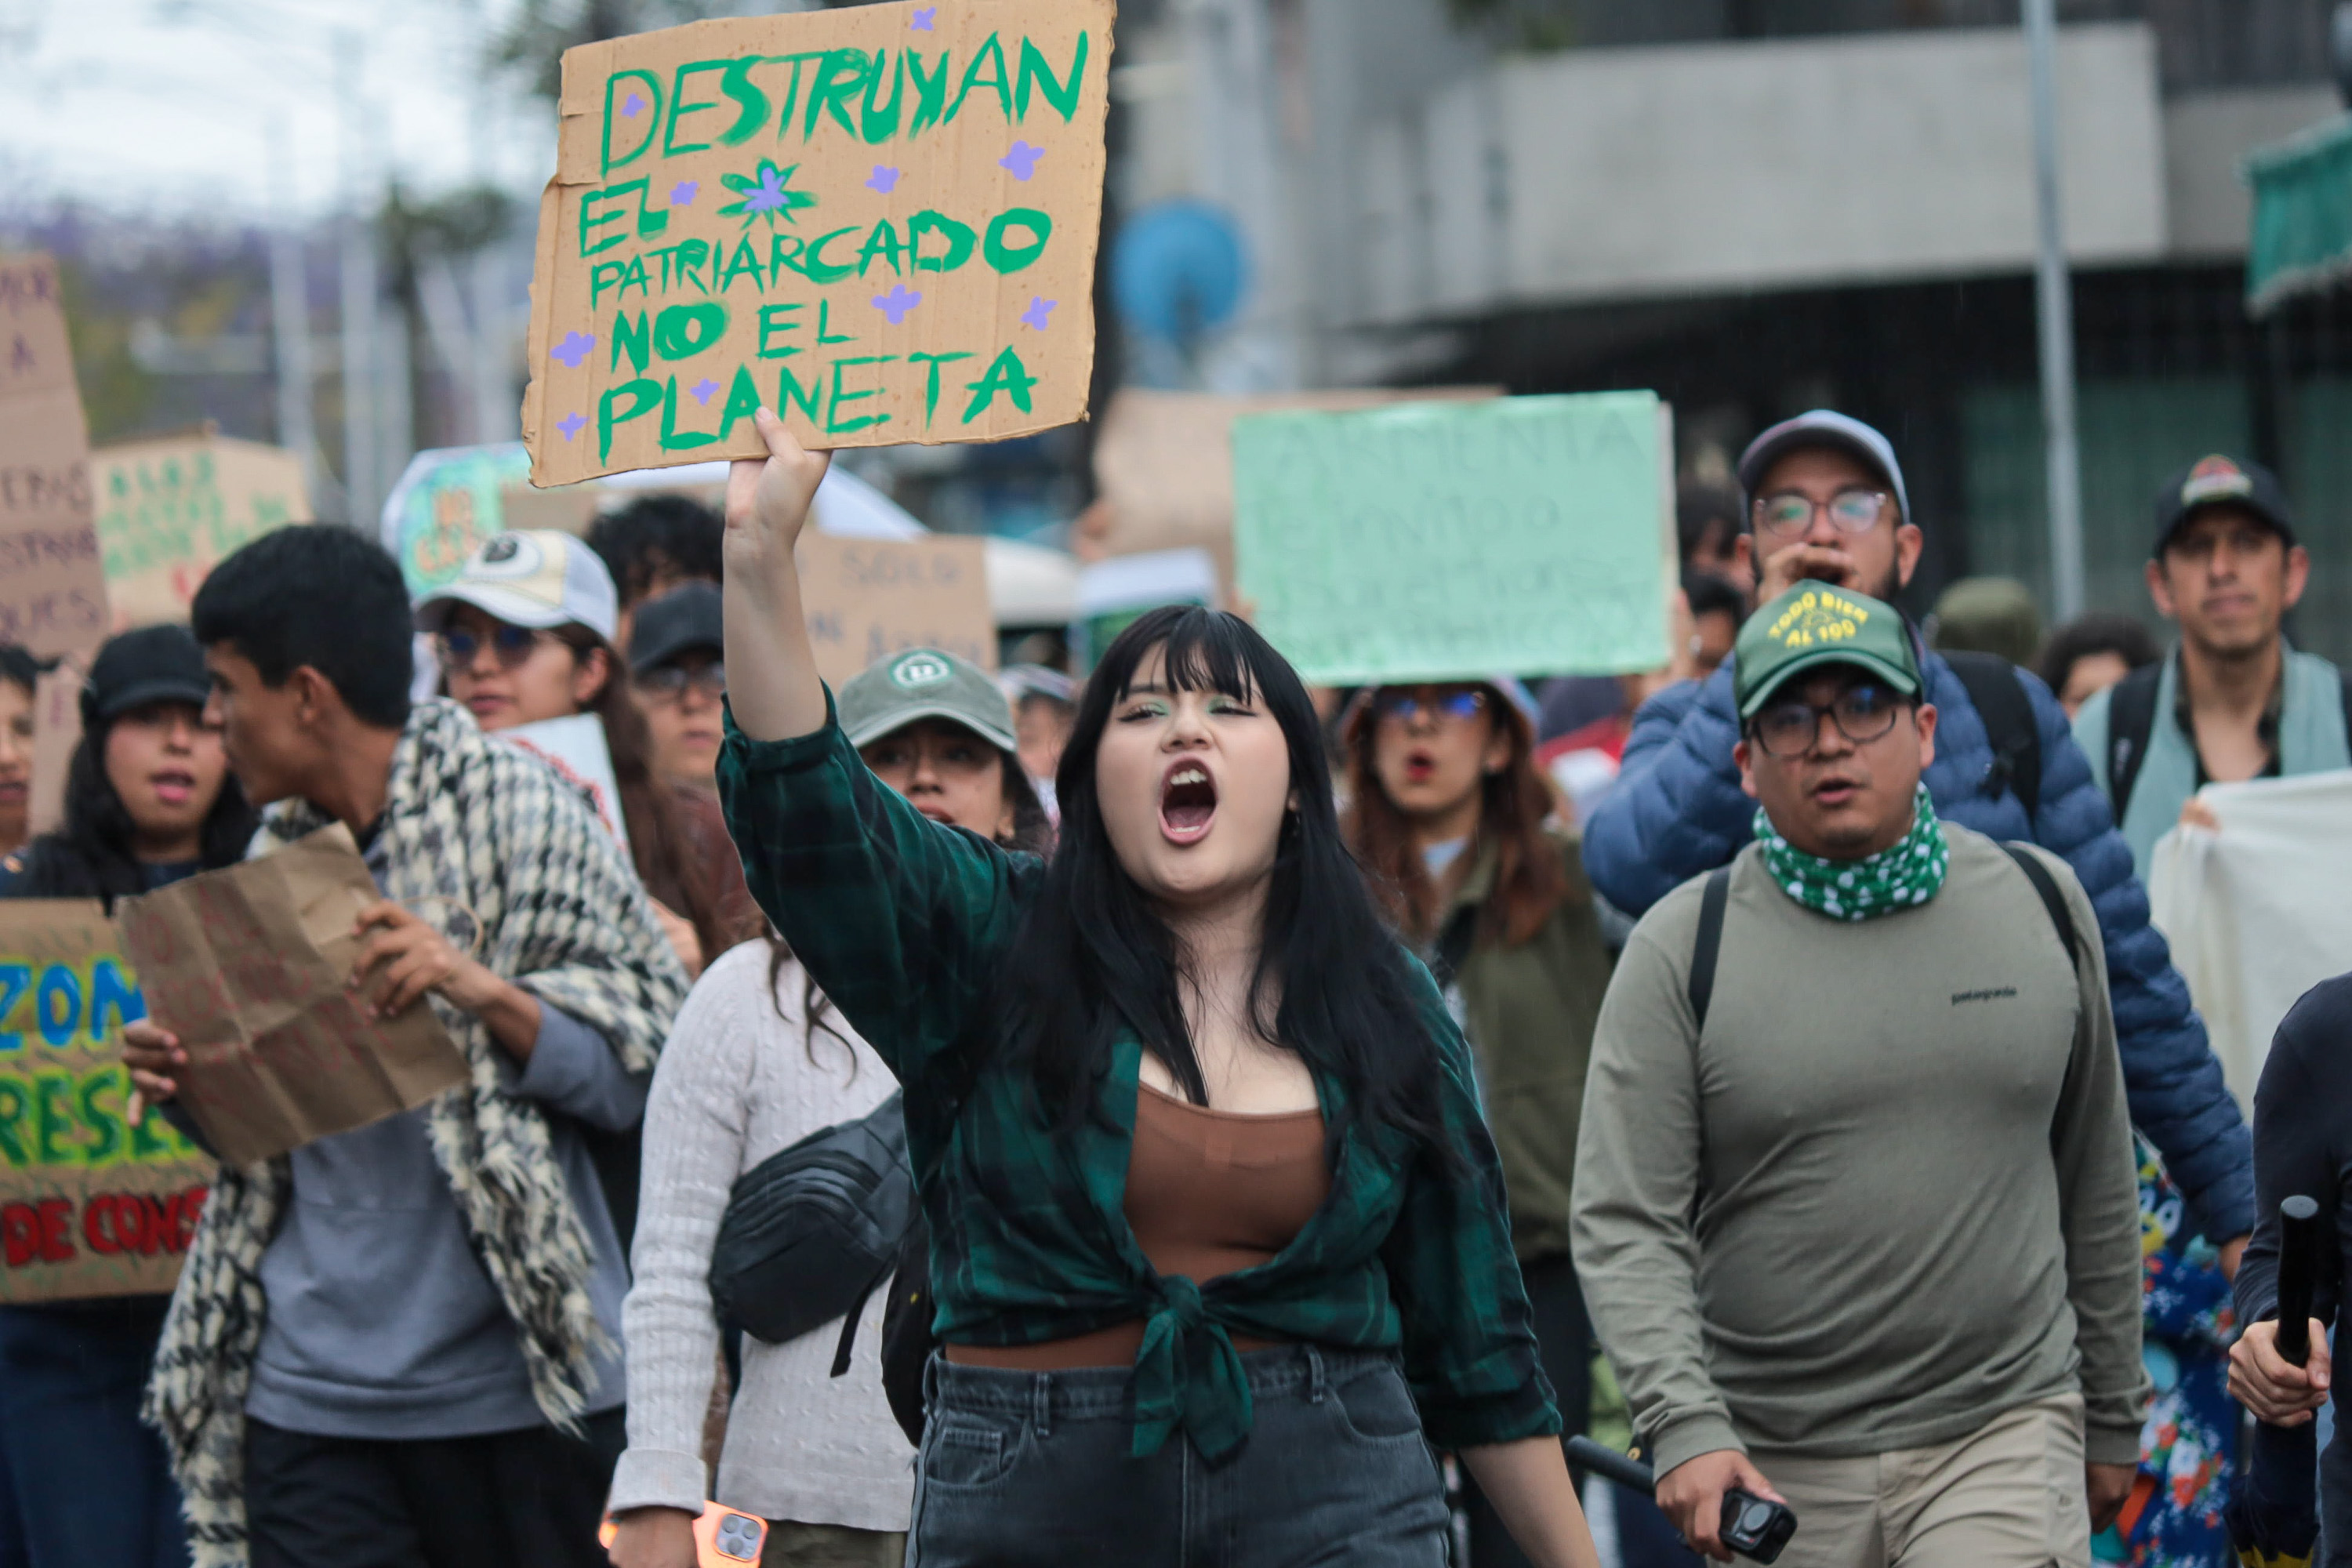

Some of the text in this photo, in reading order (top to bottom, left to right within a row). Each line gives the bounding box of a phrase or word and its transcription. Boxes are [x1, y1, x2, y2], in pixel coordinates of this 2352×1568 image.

[601, 30, 1088, 179] DESTRUYAN
[579, 174, 670, 258] EL
[590, 208, 1052, 311] PATRIARCADO
[611, 299, 862, 376] NO EL
[597, 346, 1040, 468] PLANETA
[1768, 591, 1869, 639] TODO BIEN
[1785, 619, 1857, 648] AL 100
[3, 1201, 76, 1268] DE
